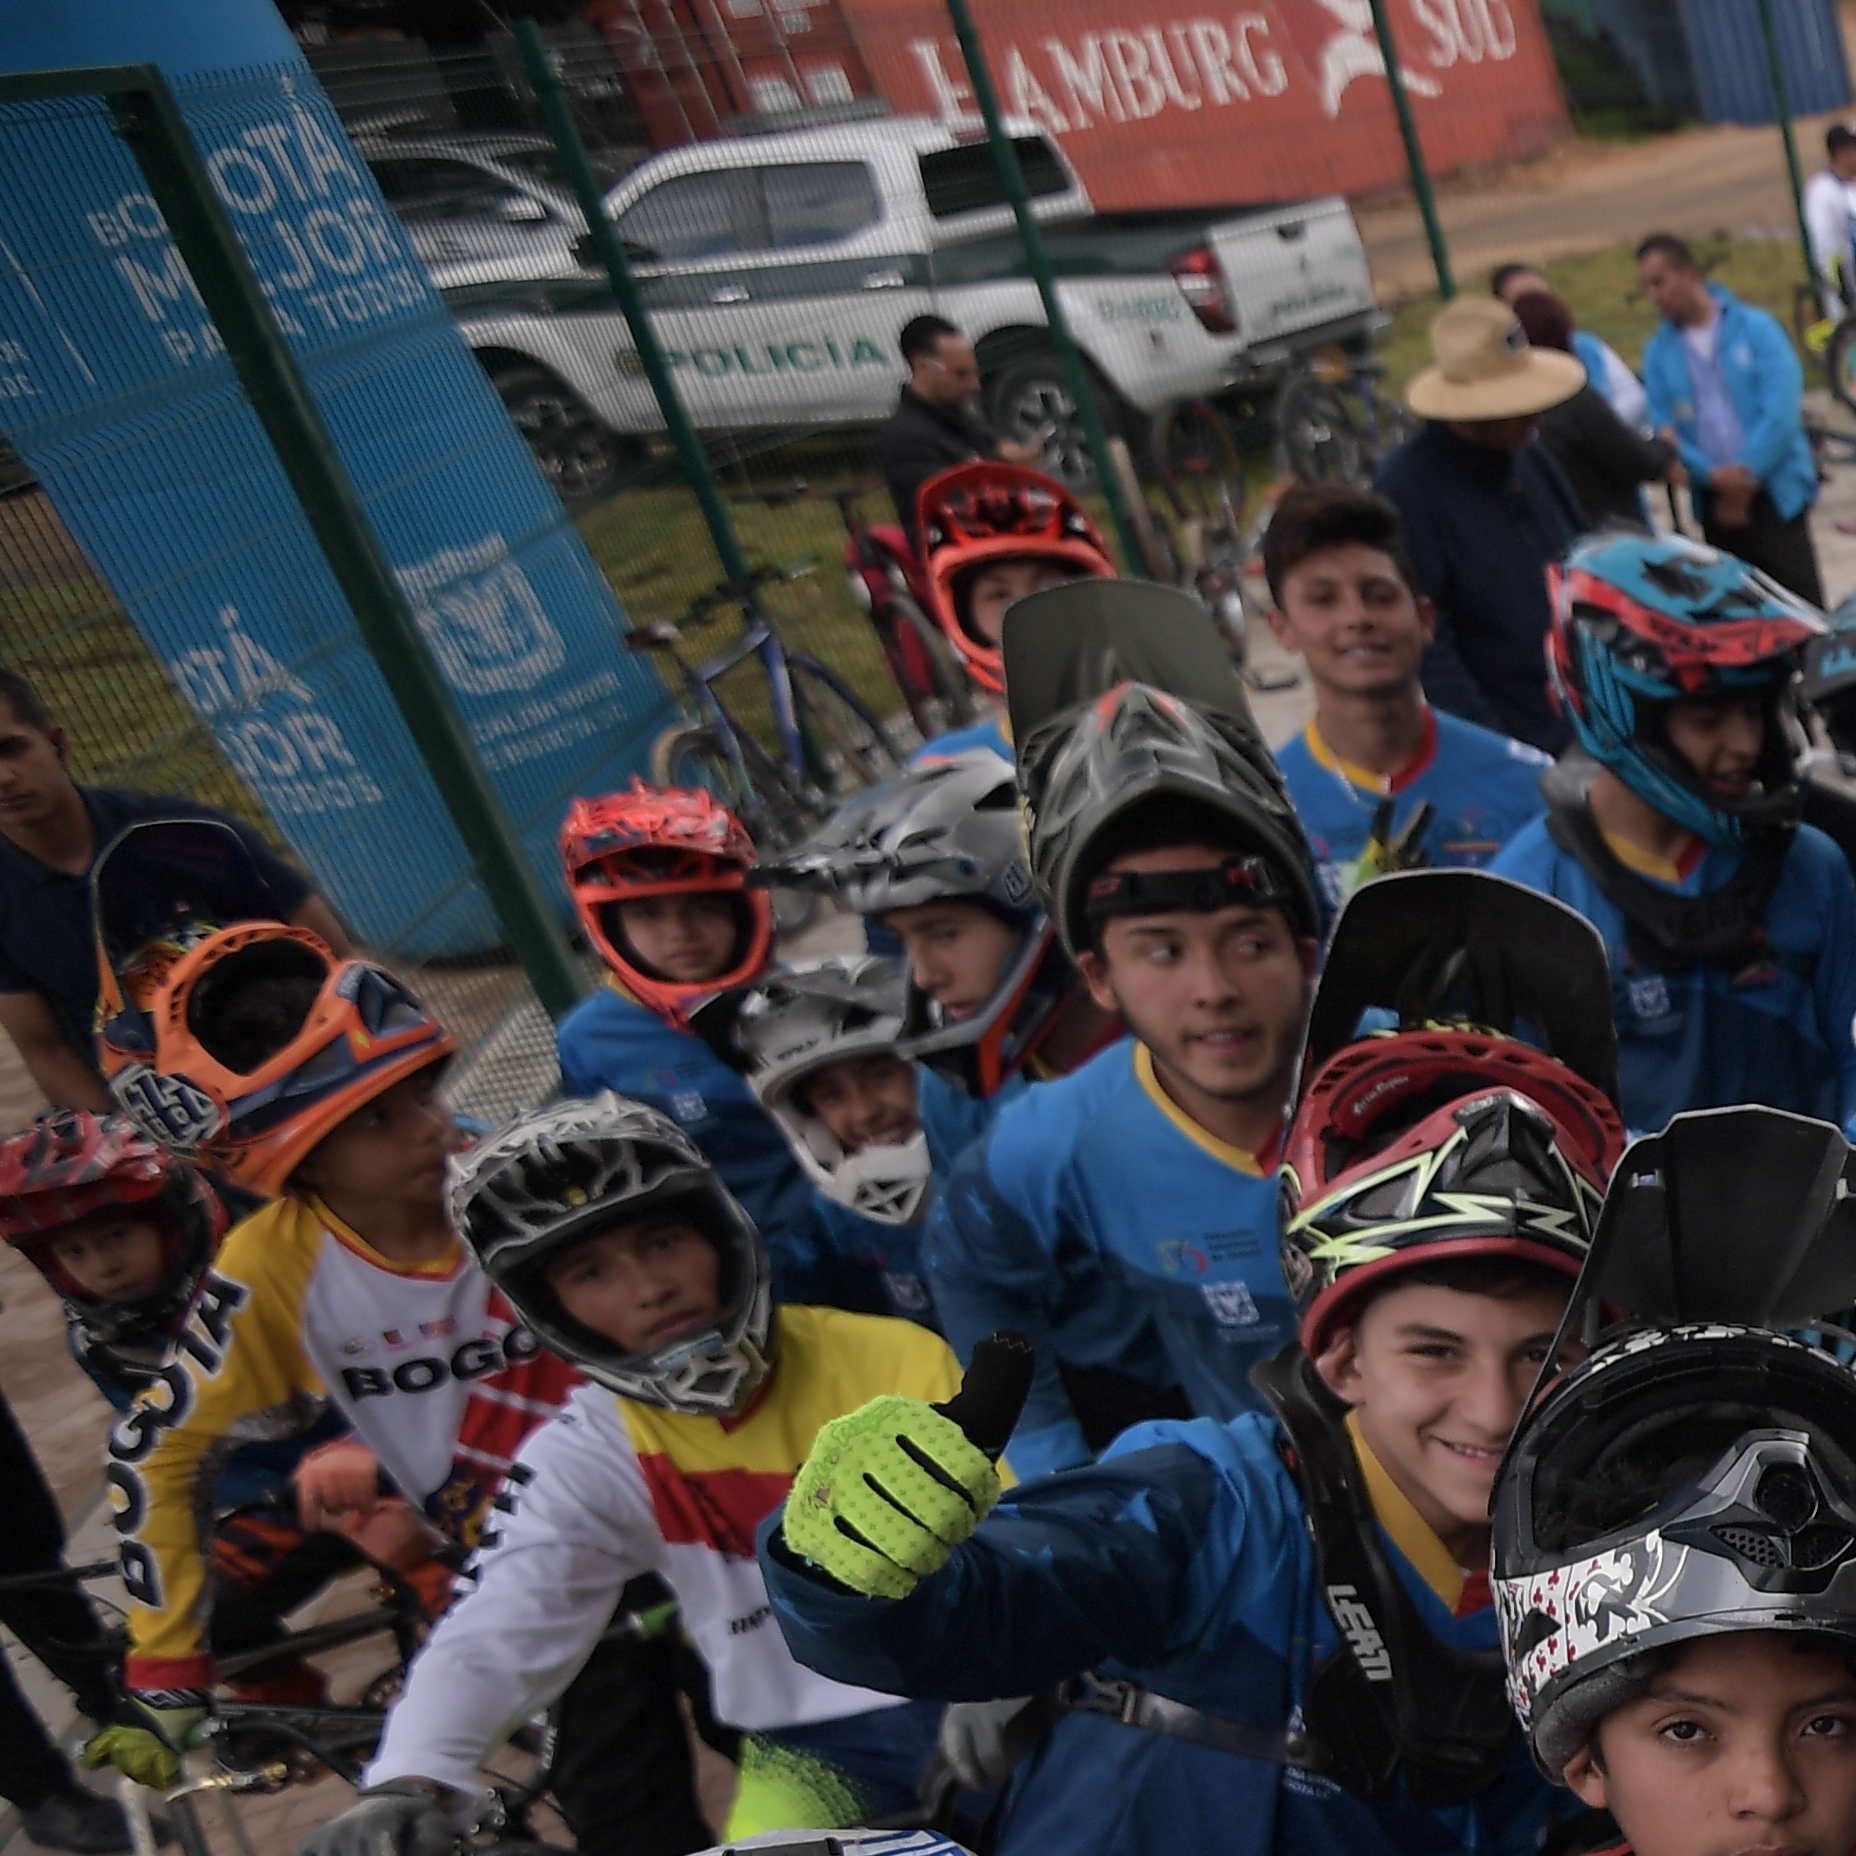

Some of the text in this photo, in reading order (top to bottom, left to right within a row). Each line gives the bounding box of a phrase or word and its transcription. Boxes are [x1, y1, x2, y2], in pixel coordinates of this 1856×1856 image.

[87, 75, 361, 248] BOOTÁ
[117, 197, 402, 325] MJOR
[162, 303, 308, 370] PAA
[340, 1324, 541, 1401] BOGO
[1327, 1584, 1393, 1680] LEATT
